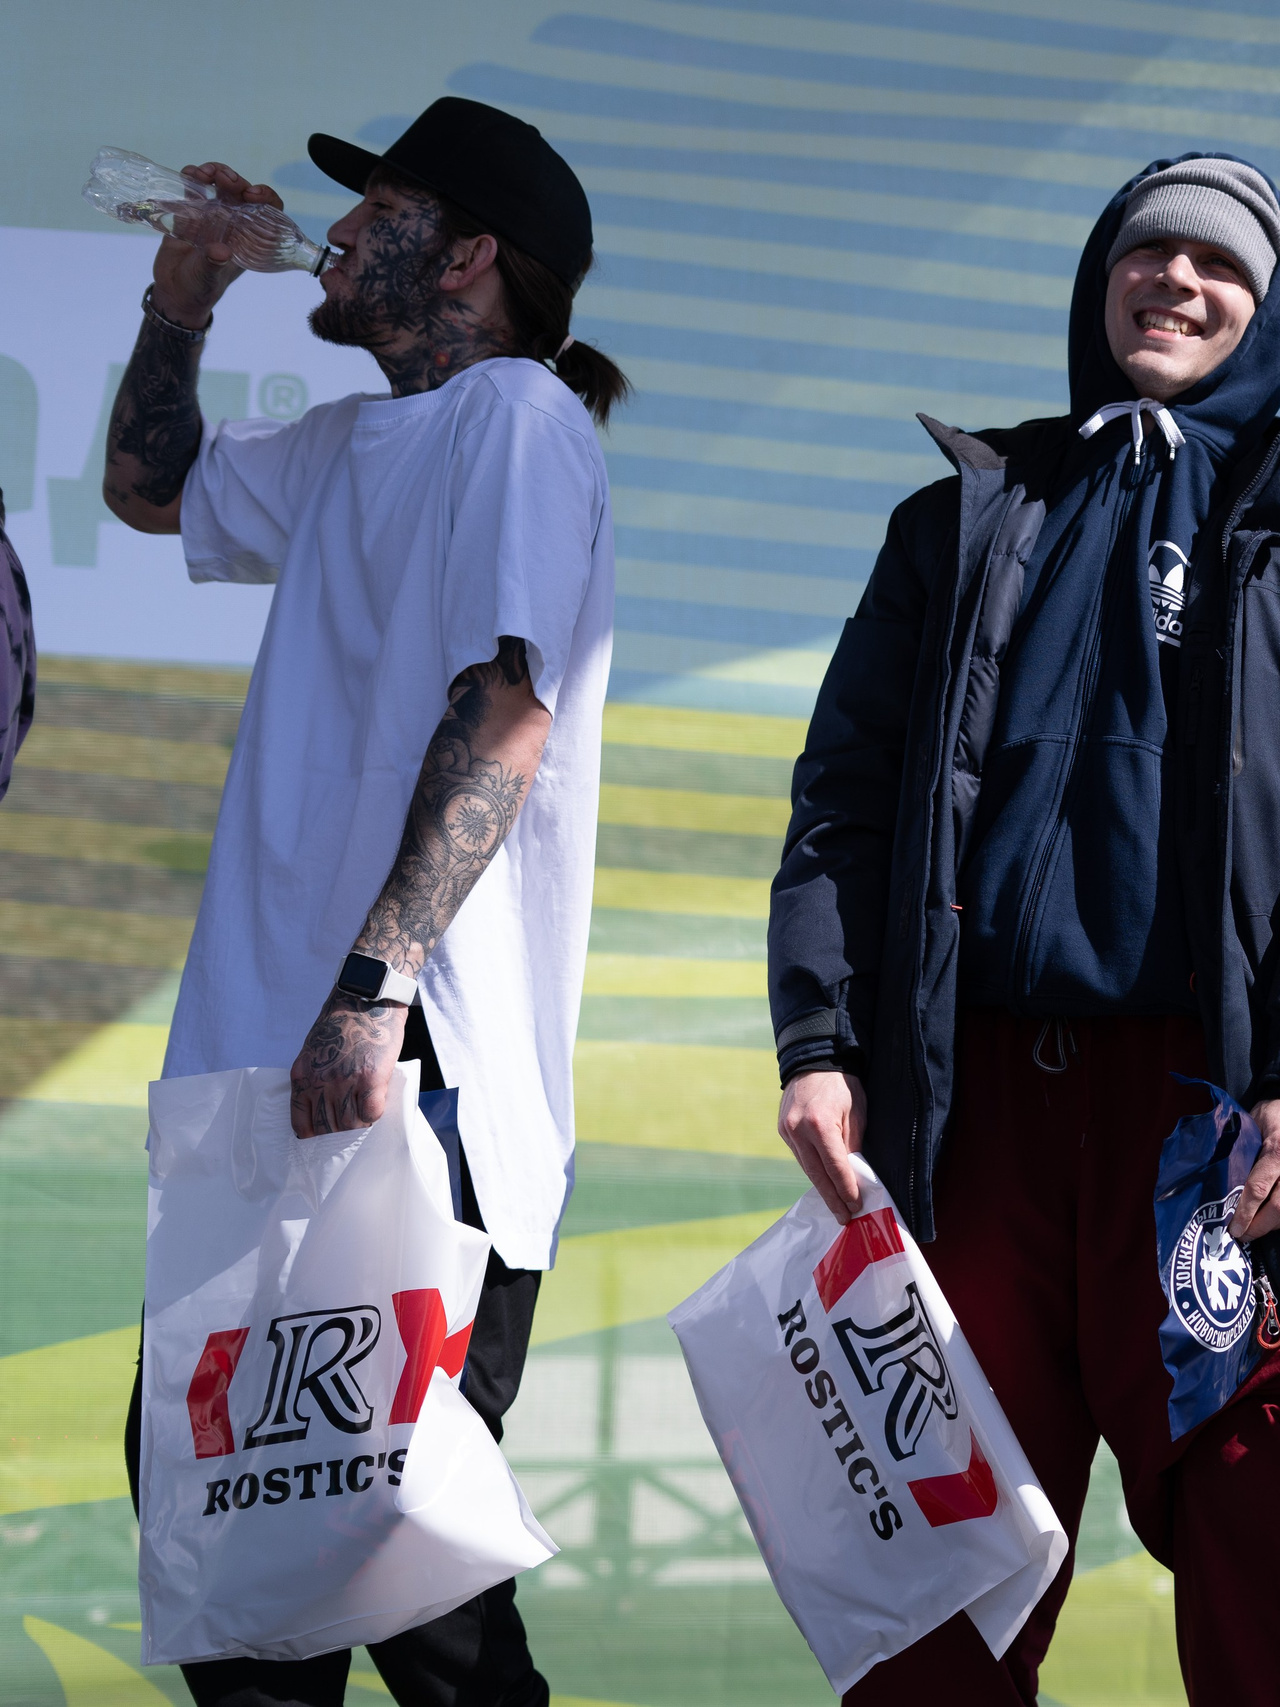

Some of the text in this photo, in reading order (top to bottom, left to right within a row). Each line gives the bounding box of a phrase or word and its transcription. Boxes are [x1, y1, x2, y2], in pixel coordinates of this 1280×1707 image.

[1177, 1204, 1218, 1291] ХОККЕЙНЫЙ
[1186, 1309, 1252, 1348] НОВОСИБИРСКАЯ
[777, 1299, 904, 1541] ROSTIC'S
[202, 1448, 409, 1517] ROSTIC'S
